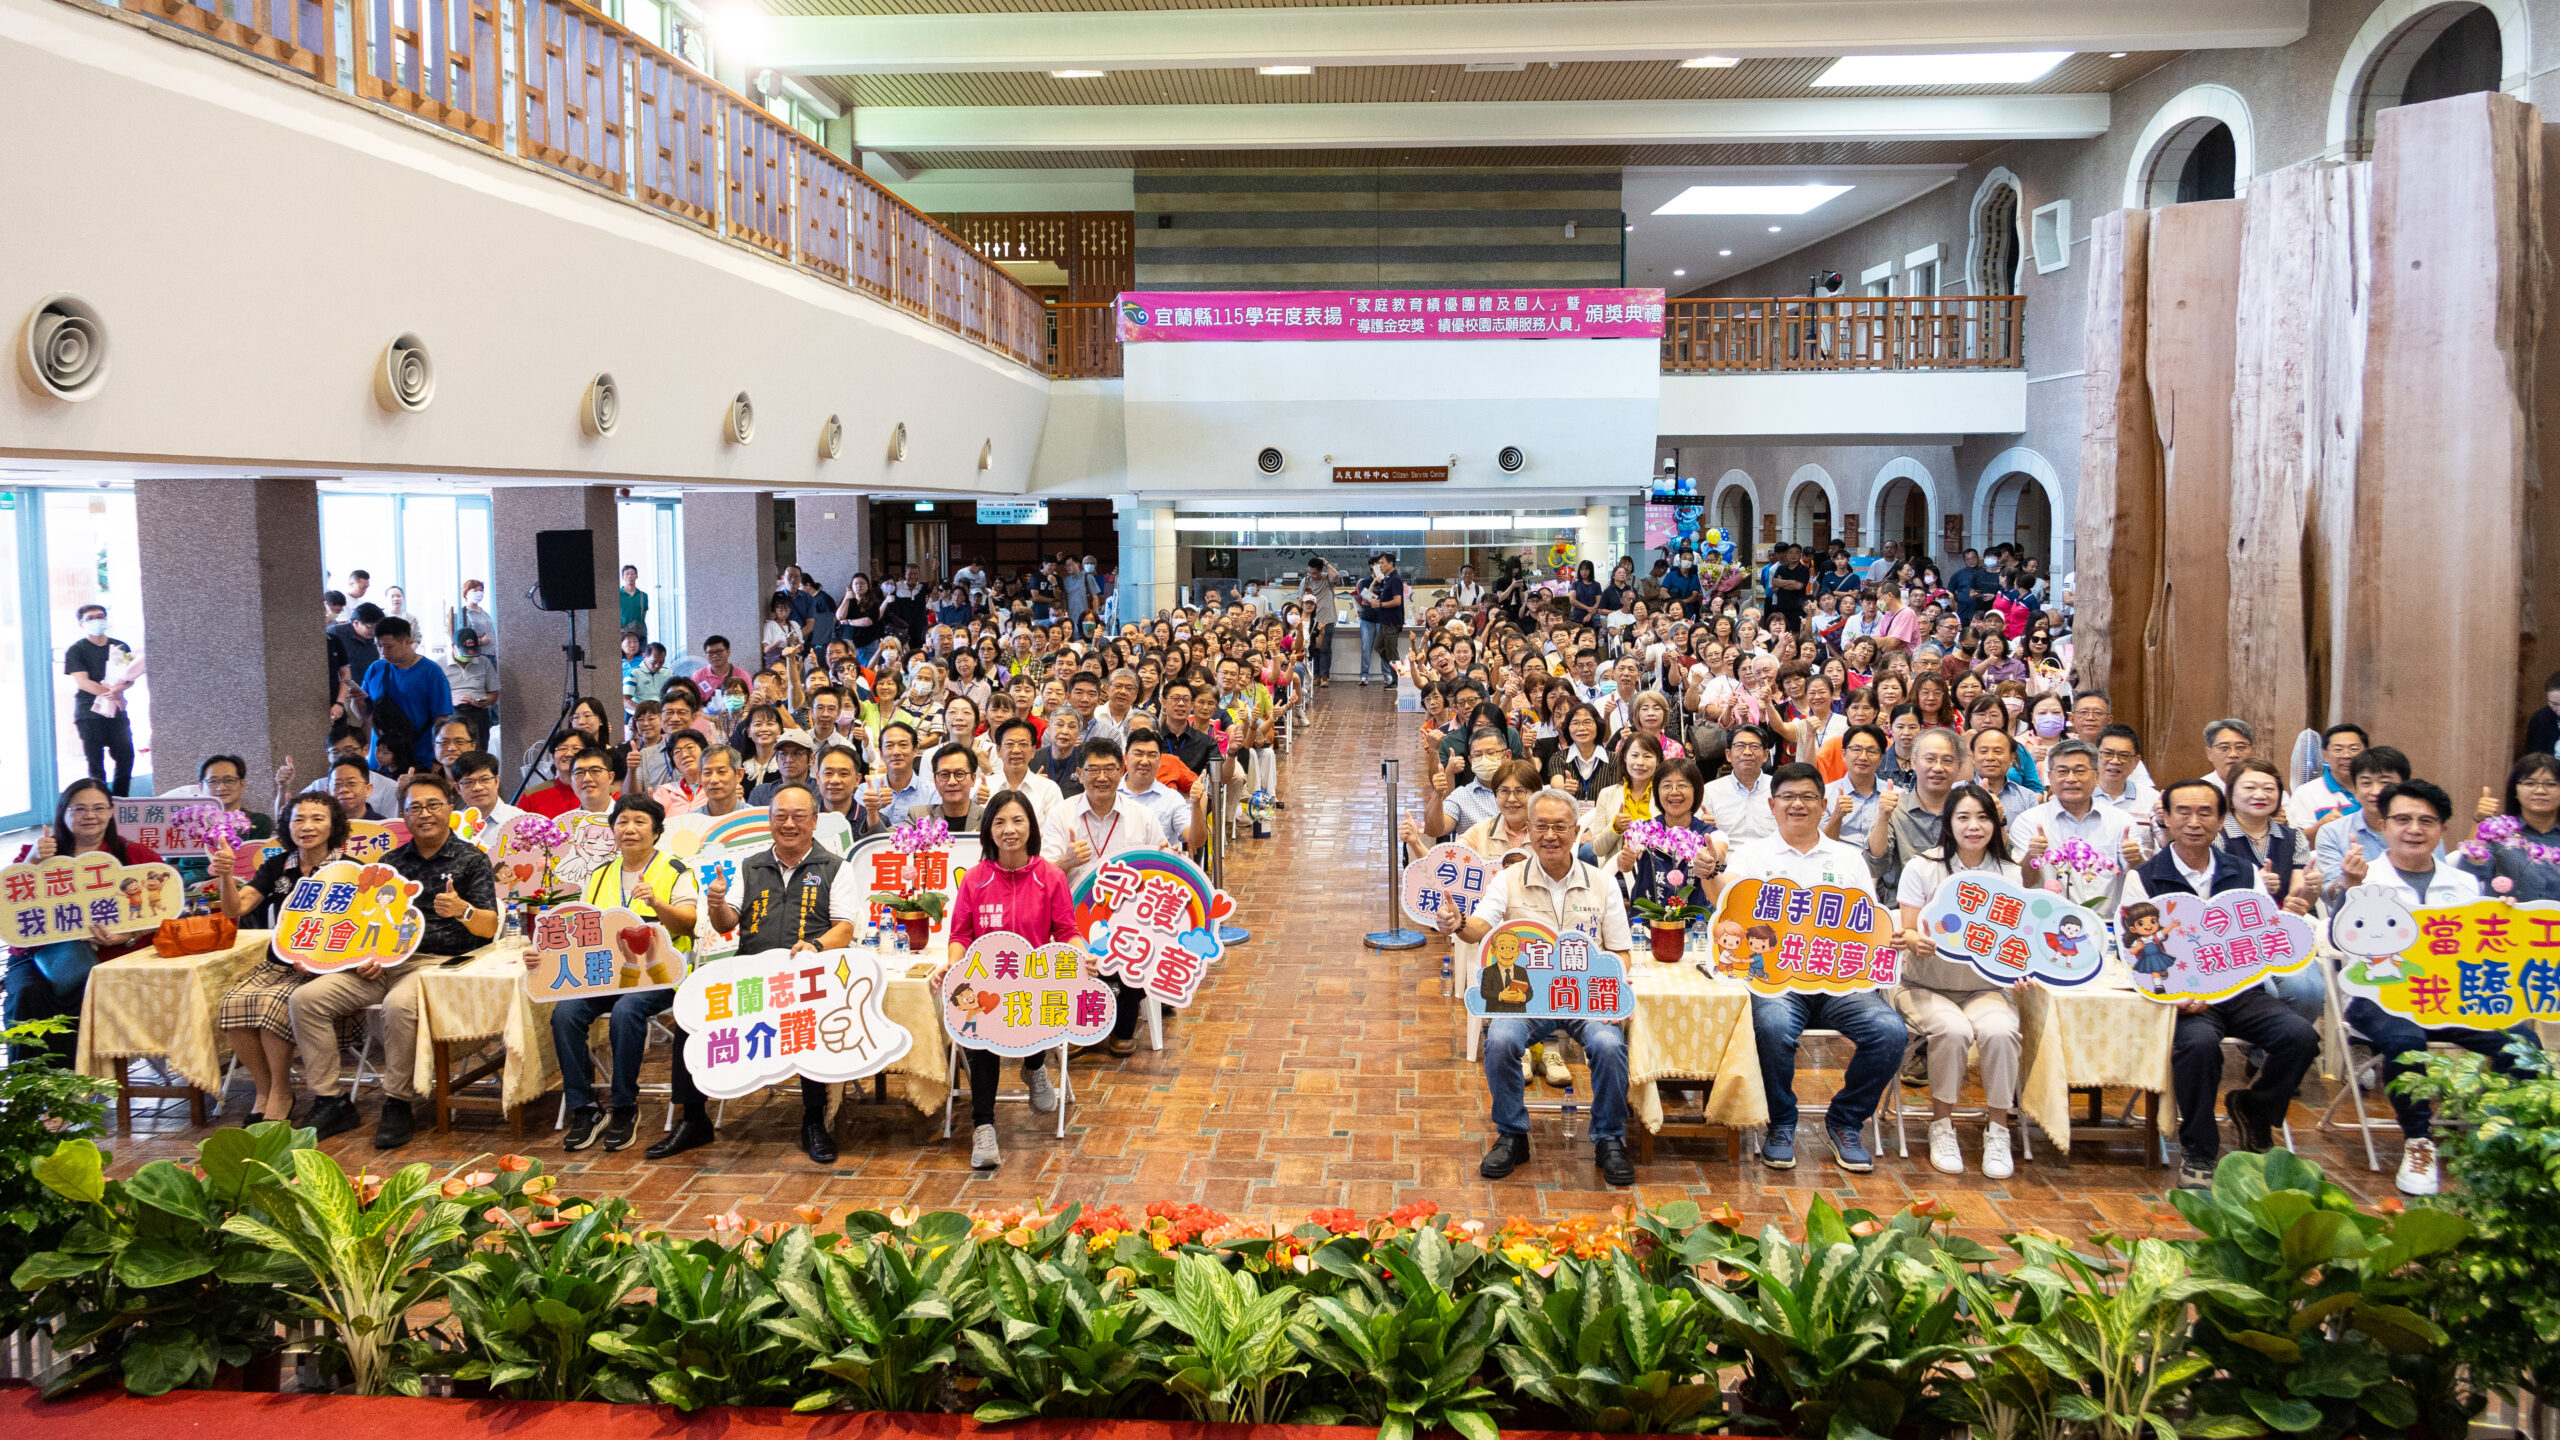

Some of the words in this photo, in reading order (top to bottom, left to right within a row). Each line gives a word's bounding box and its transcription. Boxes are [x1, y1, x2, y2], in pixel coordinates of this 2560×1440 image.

[1154, 306, 1343, 327] 宜蘭縣115學年度表揚
[1392, 471, 1409, 479] Citizen
[1411, 471, 1429, 479] Service
[1430, 470, 1446, 479] Center
[5, 863, 114, 903] 我志工
[870, 851, 949, 890] 宜蘭
[1436, 862, 1484, 892] 今日
[286, 881, 359, 913] 服務
[1095, 862, 1189, 931] 守護
[1753, 883, 1874, 933] 攜手同心
[1957, 881, 2026, 930] 守護
[17, 897, 120, 938] 我快樂
[291, 917, 359, 951] 社會
[537, 911, 603, 951] 造福
[2201, 899, 2265, 937] 今日
[2422, 913, 2560, 956] 當志工
[963, 950, 1079, 980] 人美心善
[1103, 925, 1199, 997] 兒童
[1525, 939, 1588, 971] 宜蘭
[1777, 934, 1898, 984] 共築夢想
[1964, 921, 2031, 971] 安全
[2194, 928, 2295, 976] 我最美
[550, 949, 614, 990] 人群
[2408, 958, 2560, 1016] 我驕傲
[705, 966, 827, 1022] 宜蘭志工
[1003, 989, 1107, 1028] 我最棒
[1549, 976, 1620, 1013] 尚讚
[707, 1008, 818, 1069] 尚介讚
